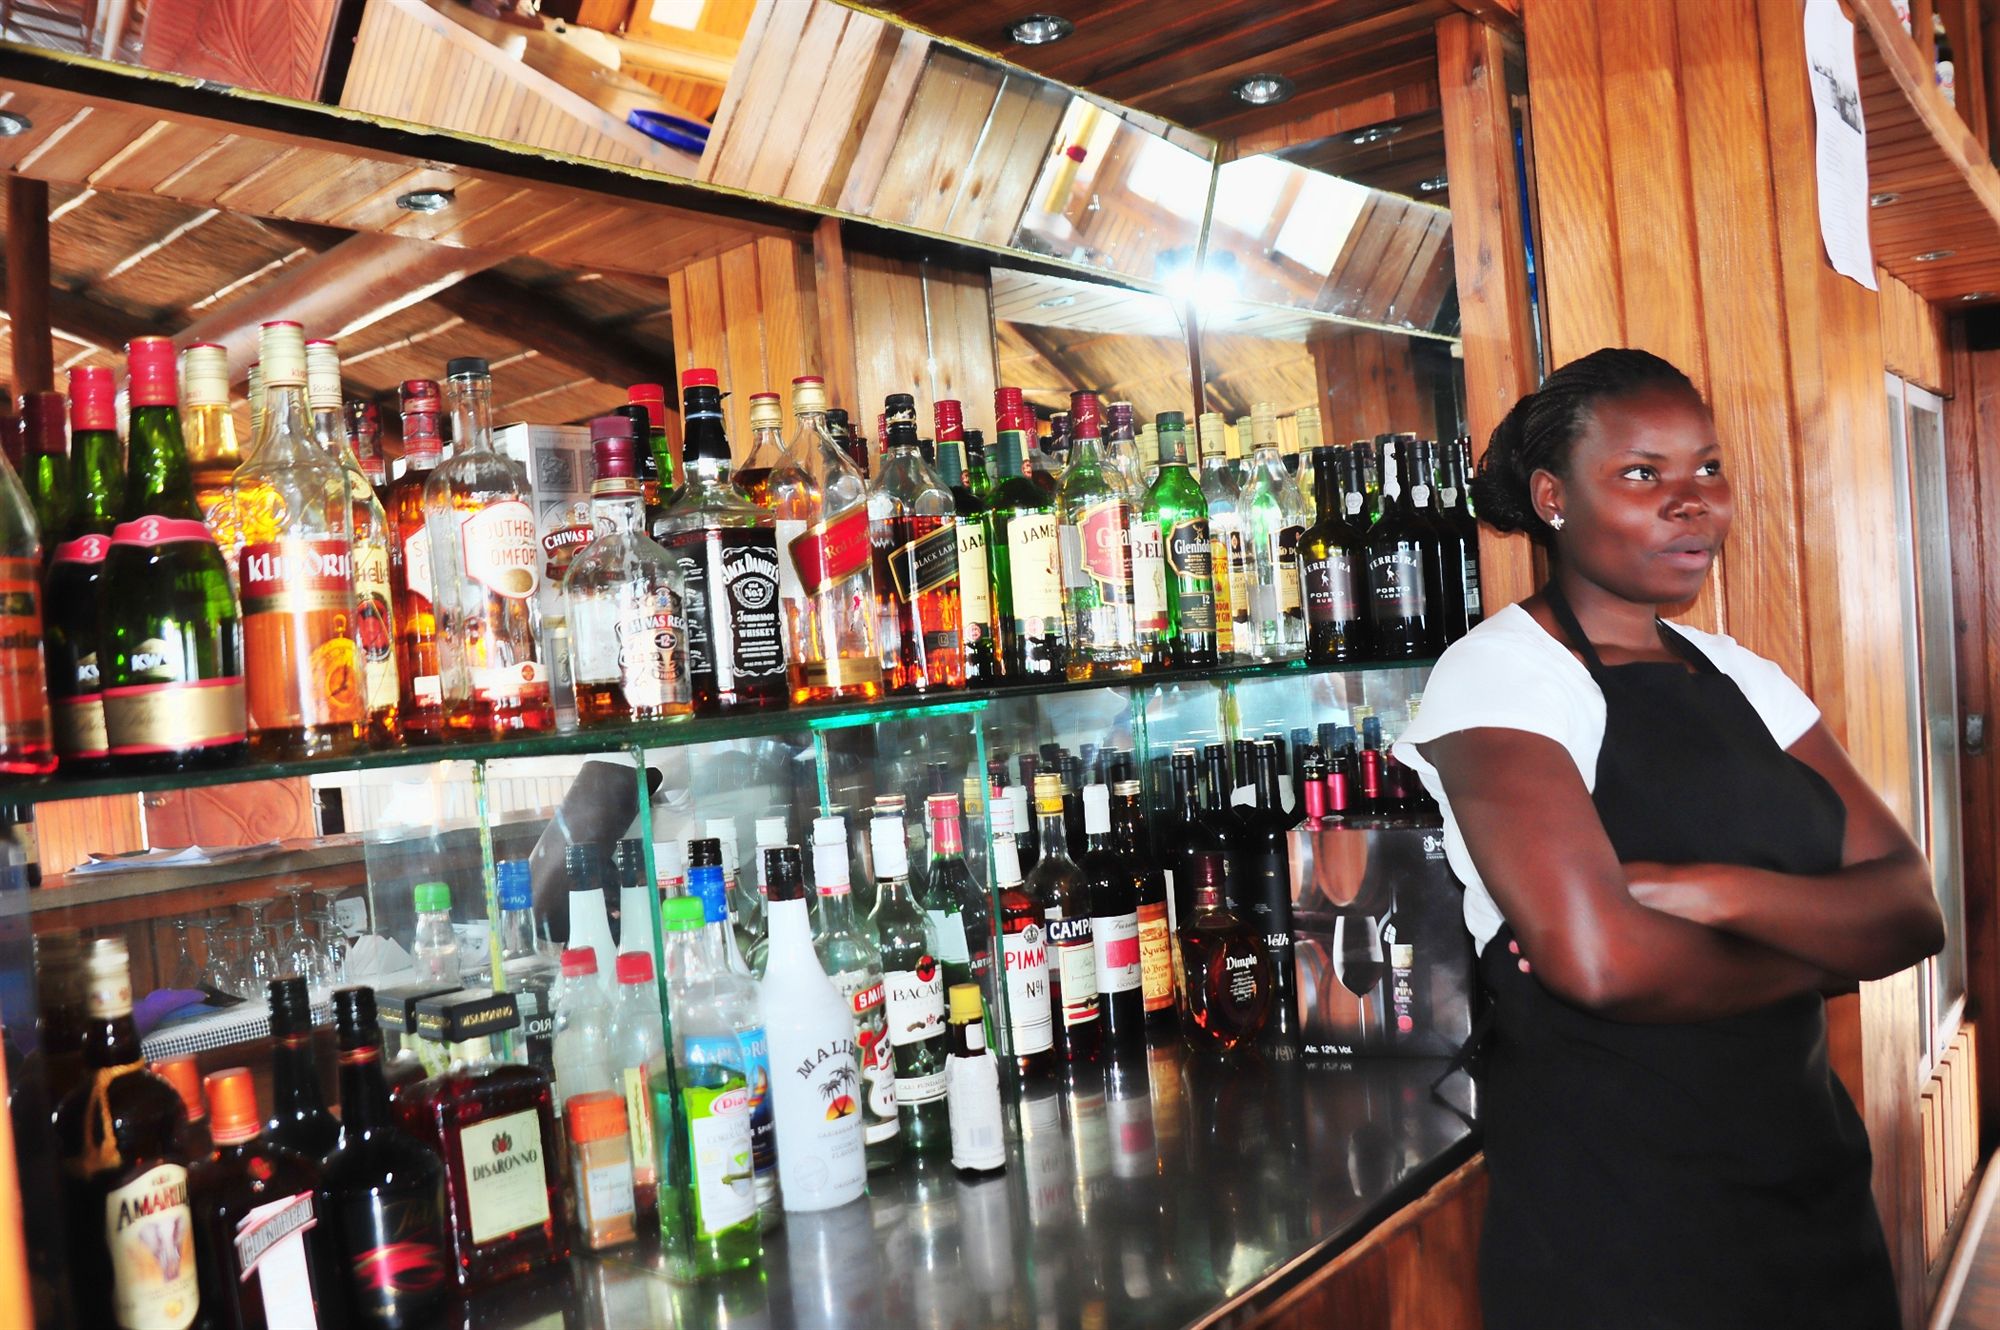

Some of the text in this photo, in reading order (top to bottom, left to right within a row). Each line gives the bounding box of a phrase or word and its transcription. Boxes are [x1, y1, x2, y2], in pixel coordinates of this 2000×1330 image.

[139, 519, 160, 541] 3
[82, 537, 100, 559] 3
[544, 531, 584, 550] CHIVAS
[913, 551, 938, 570] BLACK
[1369, 555, 1417, 572] FERREIRA
[721, 558, 746, 585] JACK
[1201, 594, 1211, 605] 12
[1310, 591, 1344, 599] PORTO
[1376, 586, 1410, 594] PORTO
[739, 628, 775, 638] WHISKEY
[1225, 944, 1258, 970] Dimple
[1320, 1045, 1337, 1054] 12%
[472, 1149, 537, 1181] DISARONNO
